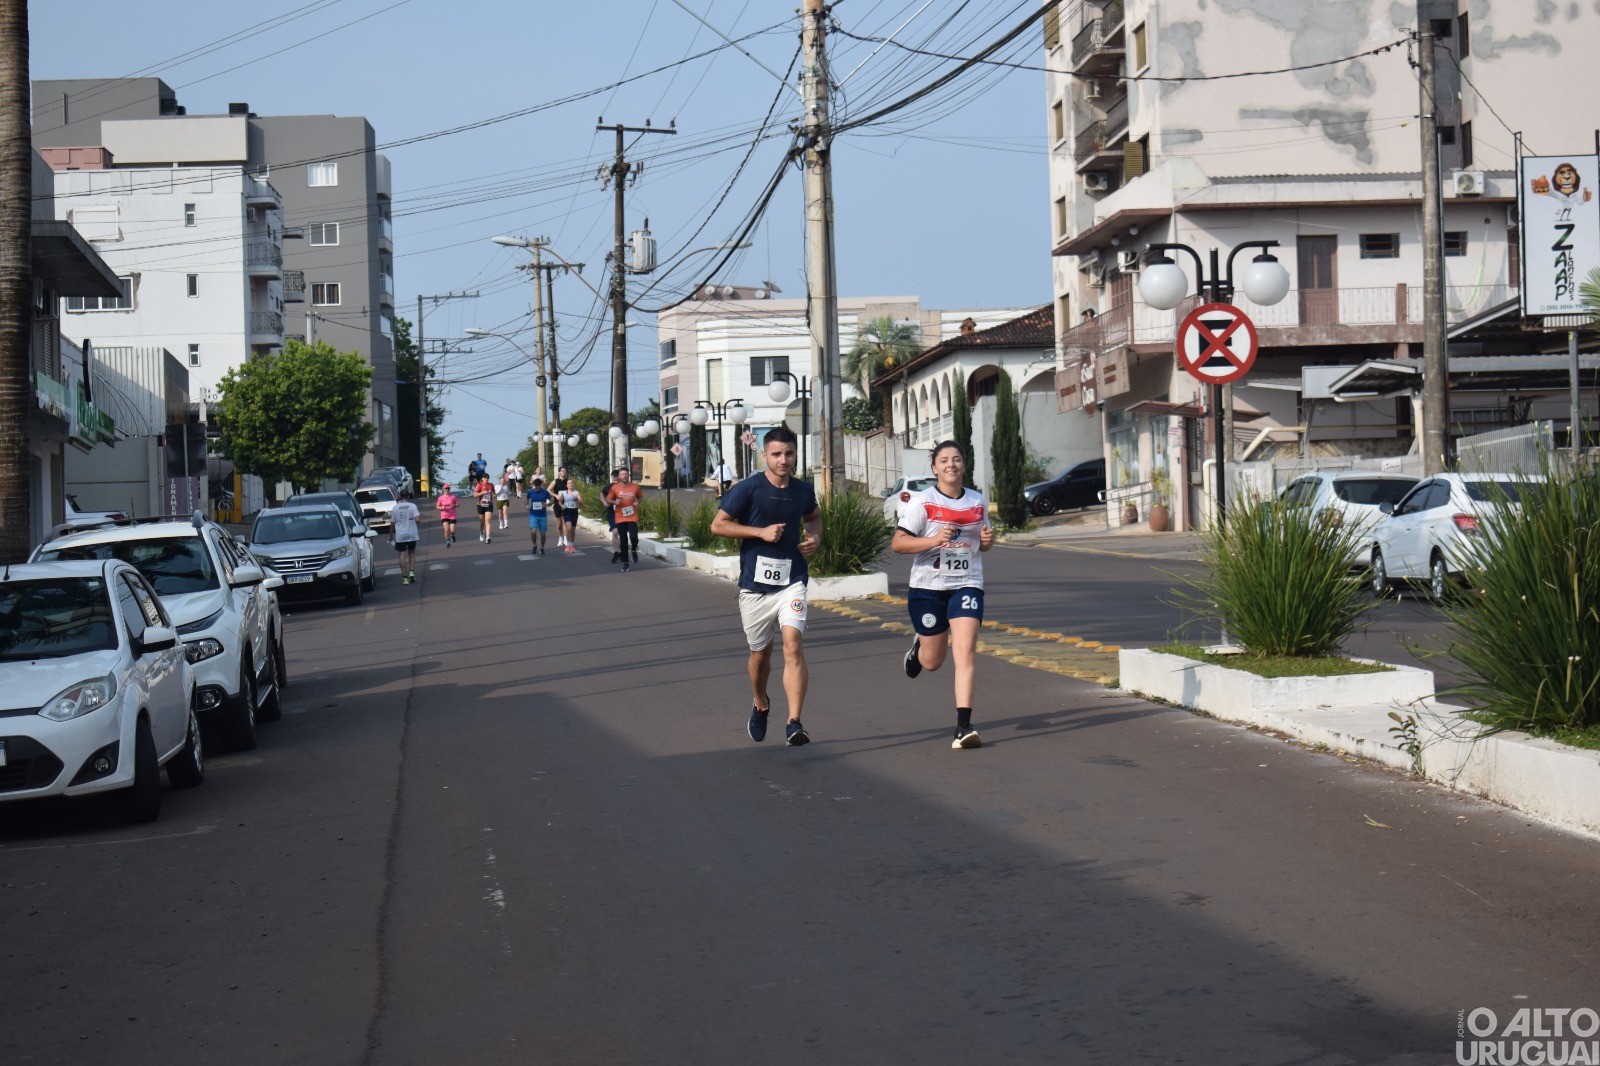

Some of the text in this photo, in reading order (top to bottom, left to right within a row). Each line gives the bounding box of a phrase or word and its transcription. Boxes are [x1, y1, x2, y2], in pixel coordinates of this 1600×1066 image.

[1551, 223, 1575, 300] ZAAP
[945, 559, 969, 570] 120
[764, 569, 781, 581] 08
[961, 595, 978, 610] 26
